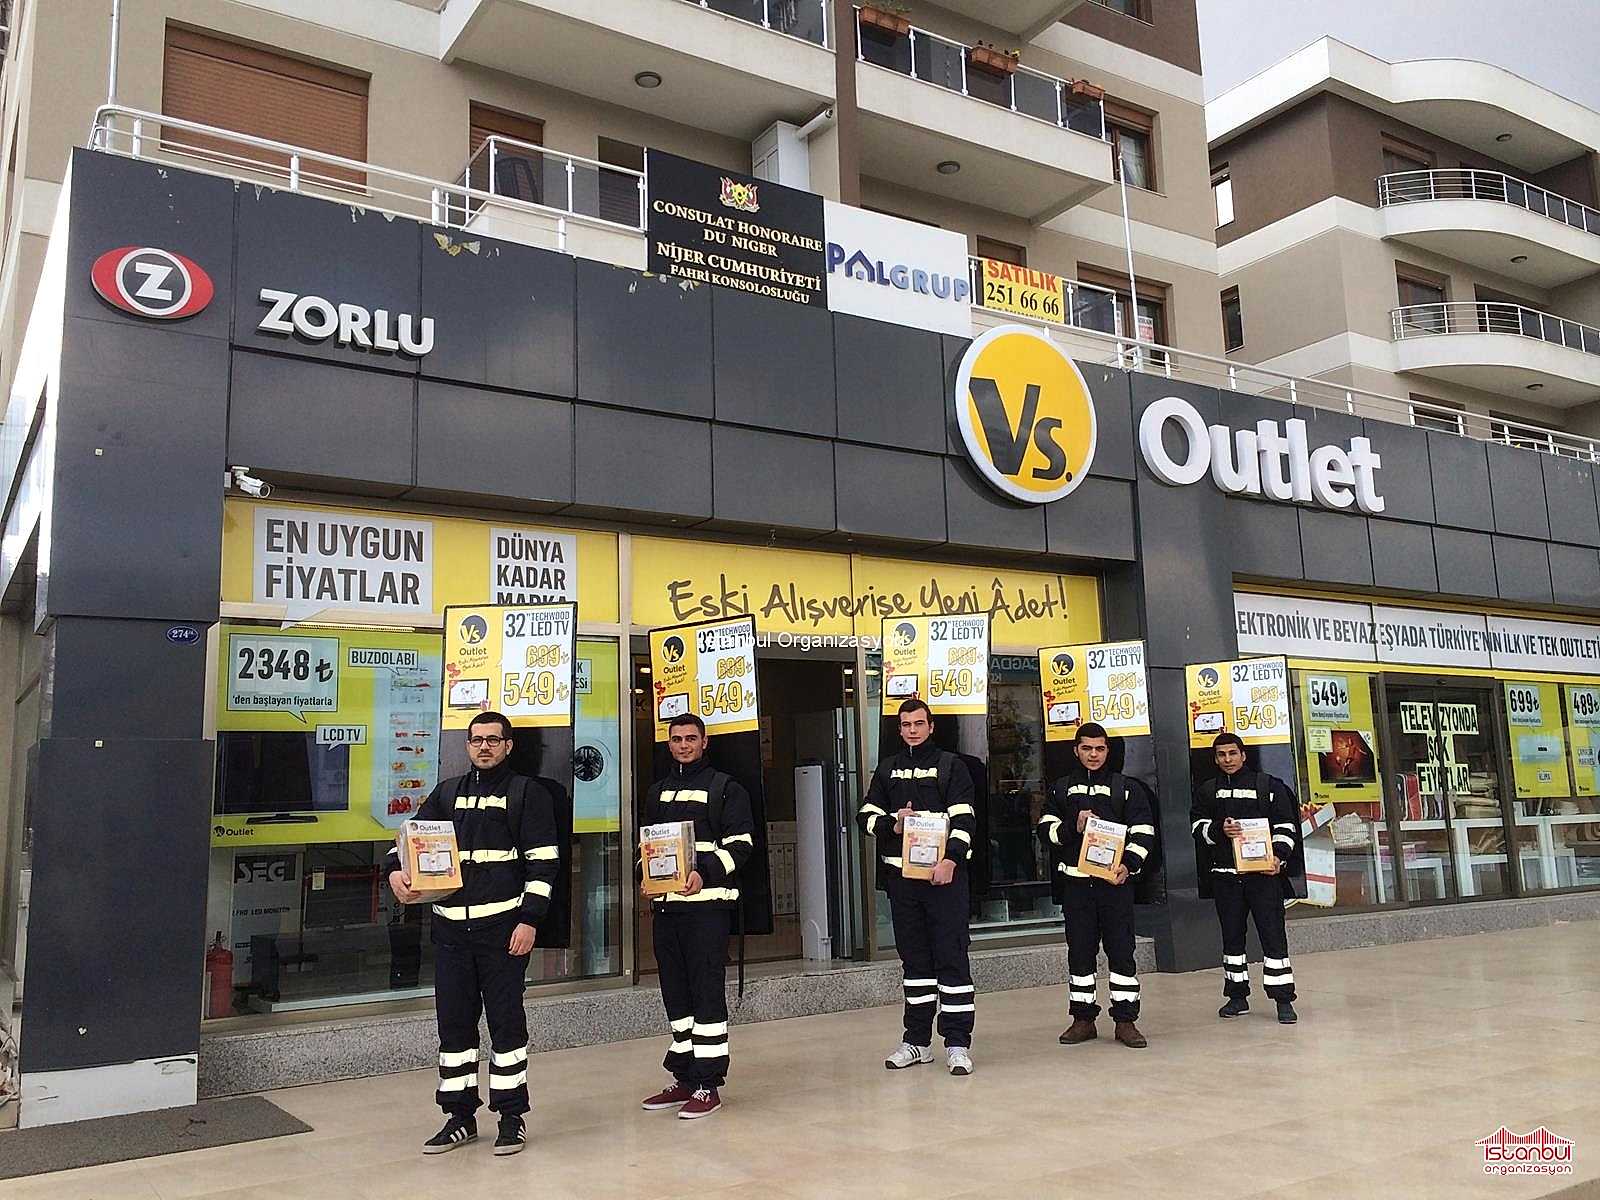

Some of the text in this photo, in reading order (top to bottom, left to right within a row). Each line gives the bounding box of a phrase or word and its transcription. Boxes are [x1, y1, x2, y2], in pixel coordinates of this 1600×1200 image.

[653, 200, 823, 251] CONSULAT HONORAIRE
[704, 228, 778, 257] DU NIGER
[656, 242, 821, 291] NİJER CUMHURİYETİ
[987, 258, 1058, 294] SATILIK
[670, 264, 810, 304] FAHRİ KONSOLOSLUĞU
[986, 282, 1014, 307] 251
[1020, 290, 1038, 312] 66
[1043, 296, 1059, 316] 66
[256, 288, 435, 357] ZORLU
[1139, 396, 1385, 513] Outlet
[265, 518, 424, 563] EN UYGUN
[497, 532, 565, 564] DÜNYA
[265, 557, 421, 606] FİYATLAR
[497, 565, 567, 591] KADAR
[667, 573, 749, 621] Eski
[530, 620, 570, 637] LED TV
[531, 611, 570, 621] TECHWOOD
[951, 626, 984, 641] LED TV
[1237, 610, 1311, 640] EKTRONİK
[1313, 617, 1331, 641] VE
[1333, 619, 1378, 644] BEYAZ
[1380, 623, 1427, 650] EŞYADA
[1503, 627, 1523, 654] İLK
[1522, 634, 1536, 656] VE
[1537, 635, 1559, 657] TEK
[238, 647, 311, 681] 2348
[351, 650, 415, 666] BUZDOLABI
[459, 647, 487, 656] Outlet
[893, 648, 916, 656] Outlet
[1109, 653, 1142, 668] LED TV
[664, 664, 686, 674] Outlet
[1053, 677, 1076, 685] Outlet
[1252, 668, 1284, 681] LED TV
[252, 696, 292, 707] başlayan
[293, 696, 333, 707] fiyatlarla
[503, 671, 555, 706] 549
[1401, 704, 1478, 731] TELEVZYONDA
[323, 728, 361, 742] LCD TV
[225, 828, 255, 836] Outlet
